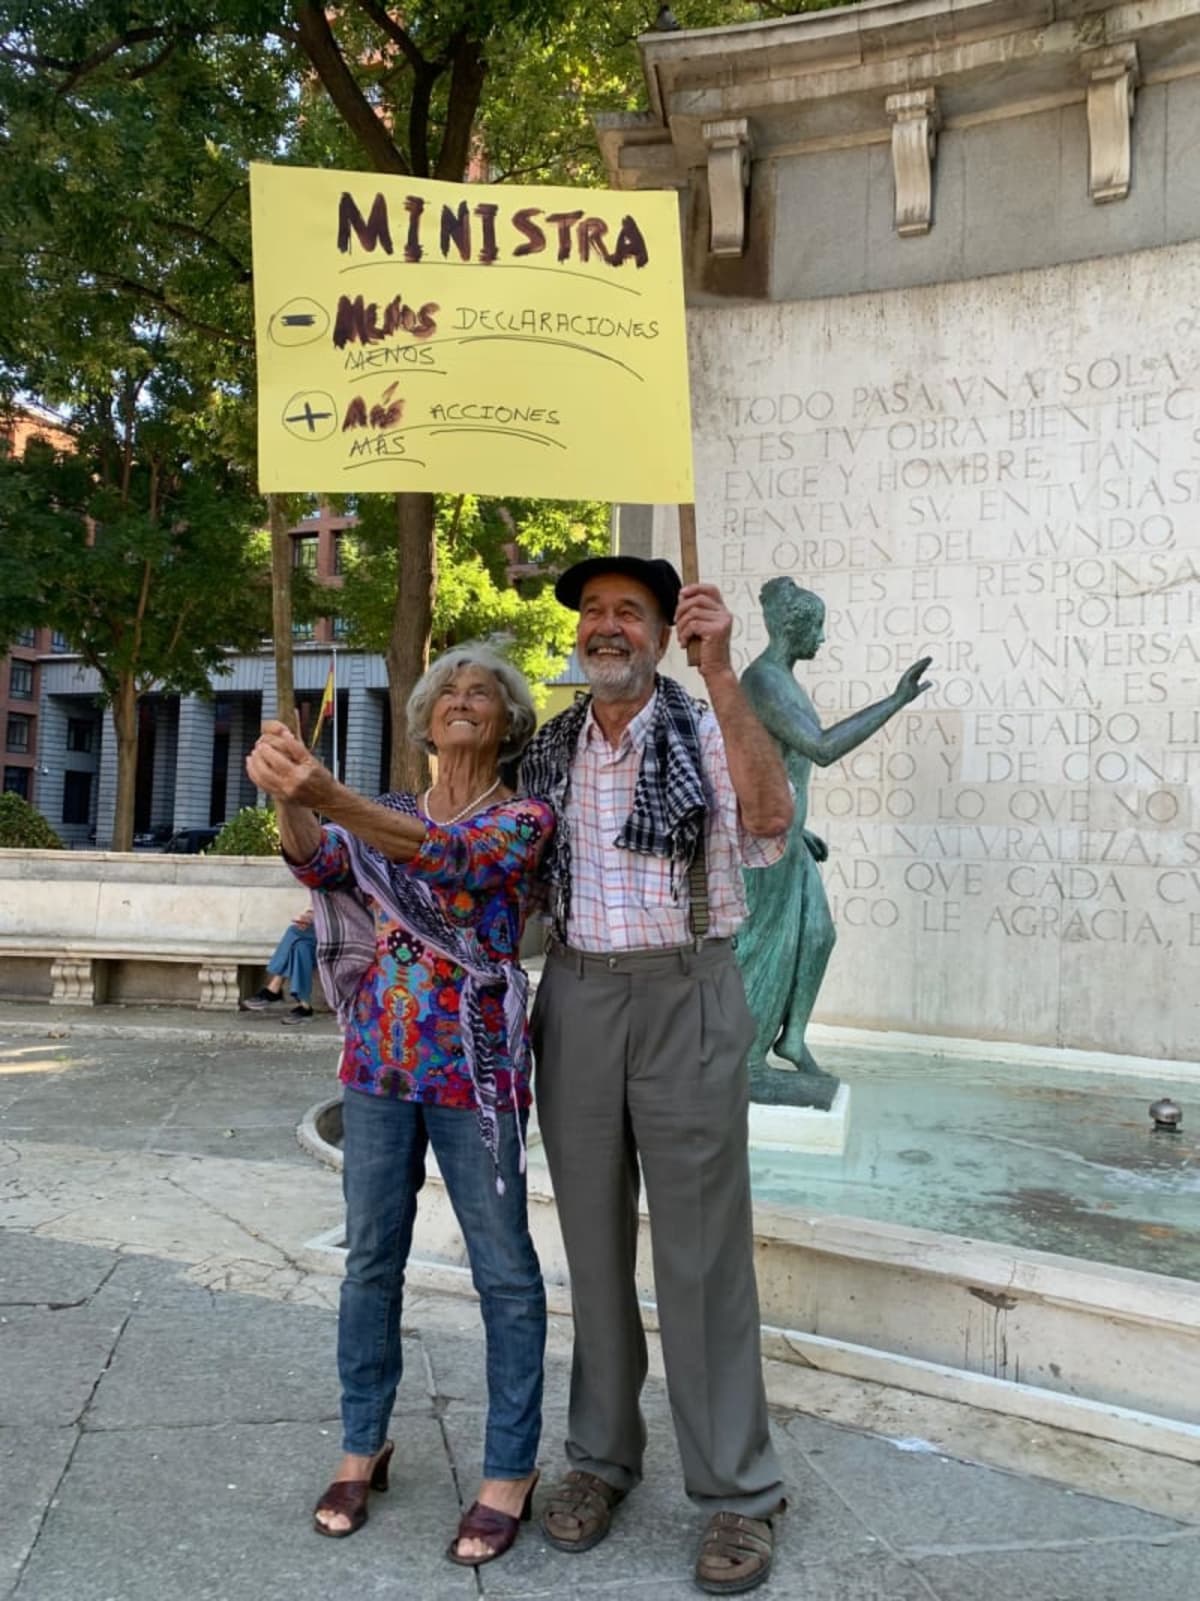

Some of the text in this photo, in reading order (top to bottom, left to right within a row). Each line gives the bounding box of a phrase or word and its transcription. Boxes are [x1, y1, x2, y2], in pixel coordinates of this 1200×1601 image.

[337, 191, 650, 269] MINISTRA
[452, 307, 660, 339] DECLARACIONES
[345, 345, 435, 370] MENOS
[725, 390, 835, 427] TODO
[1062, 351, 1180, 395] SOLA
[430, 403, 560, 426] ACCIONES
[727, 434, 741, 464] Y
[758, 430, 794, 462] ES
[887, 416, 987, 451] OBRA
[1008, 403, 1093, 441] BIEN
[838, 464, 857, 495] Y
[877, 446, 1051, 493] HOMBRE,
[1068, 432, 1161, 475] TAN
[979, 469, 1200, 522] ENTVSIAS
[721, 543, 754, 573] EL
[772, 536, 892, 570] ORDEN
[915, 528, 984, 563] DEL
[850, 571, 887, 602] ES
[911, 567, 953, 601] EL
[979, 602, 1029, 633] LA
[1124, 671, 1167, 705] ES
[974, 711, 1140, 745] ESTADO
[939, 751, 961, 782] Y
[986, 751, 1038, 784] DE
[937, 788, 985, 820] LO
[1008, 788, 1090, 825] QVE
[825, 823, 869, 853] LA
[879, 826, 1162, 868] NATVRALEZA,
[904, 861, 982, 897] QVE
[1007, 865, 1127, 903] CADA
[832, 895, 899, 928] ICO
[923, 900, 960, 932] LE
